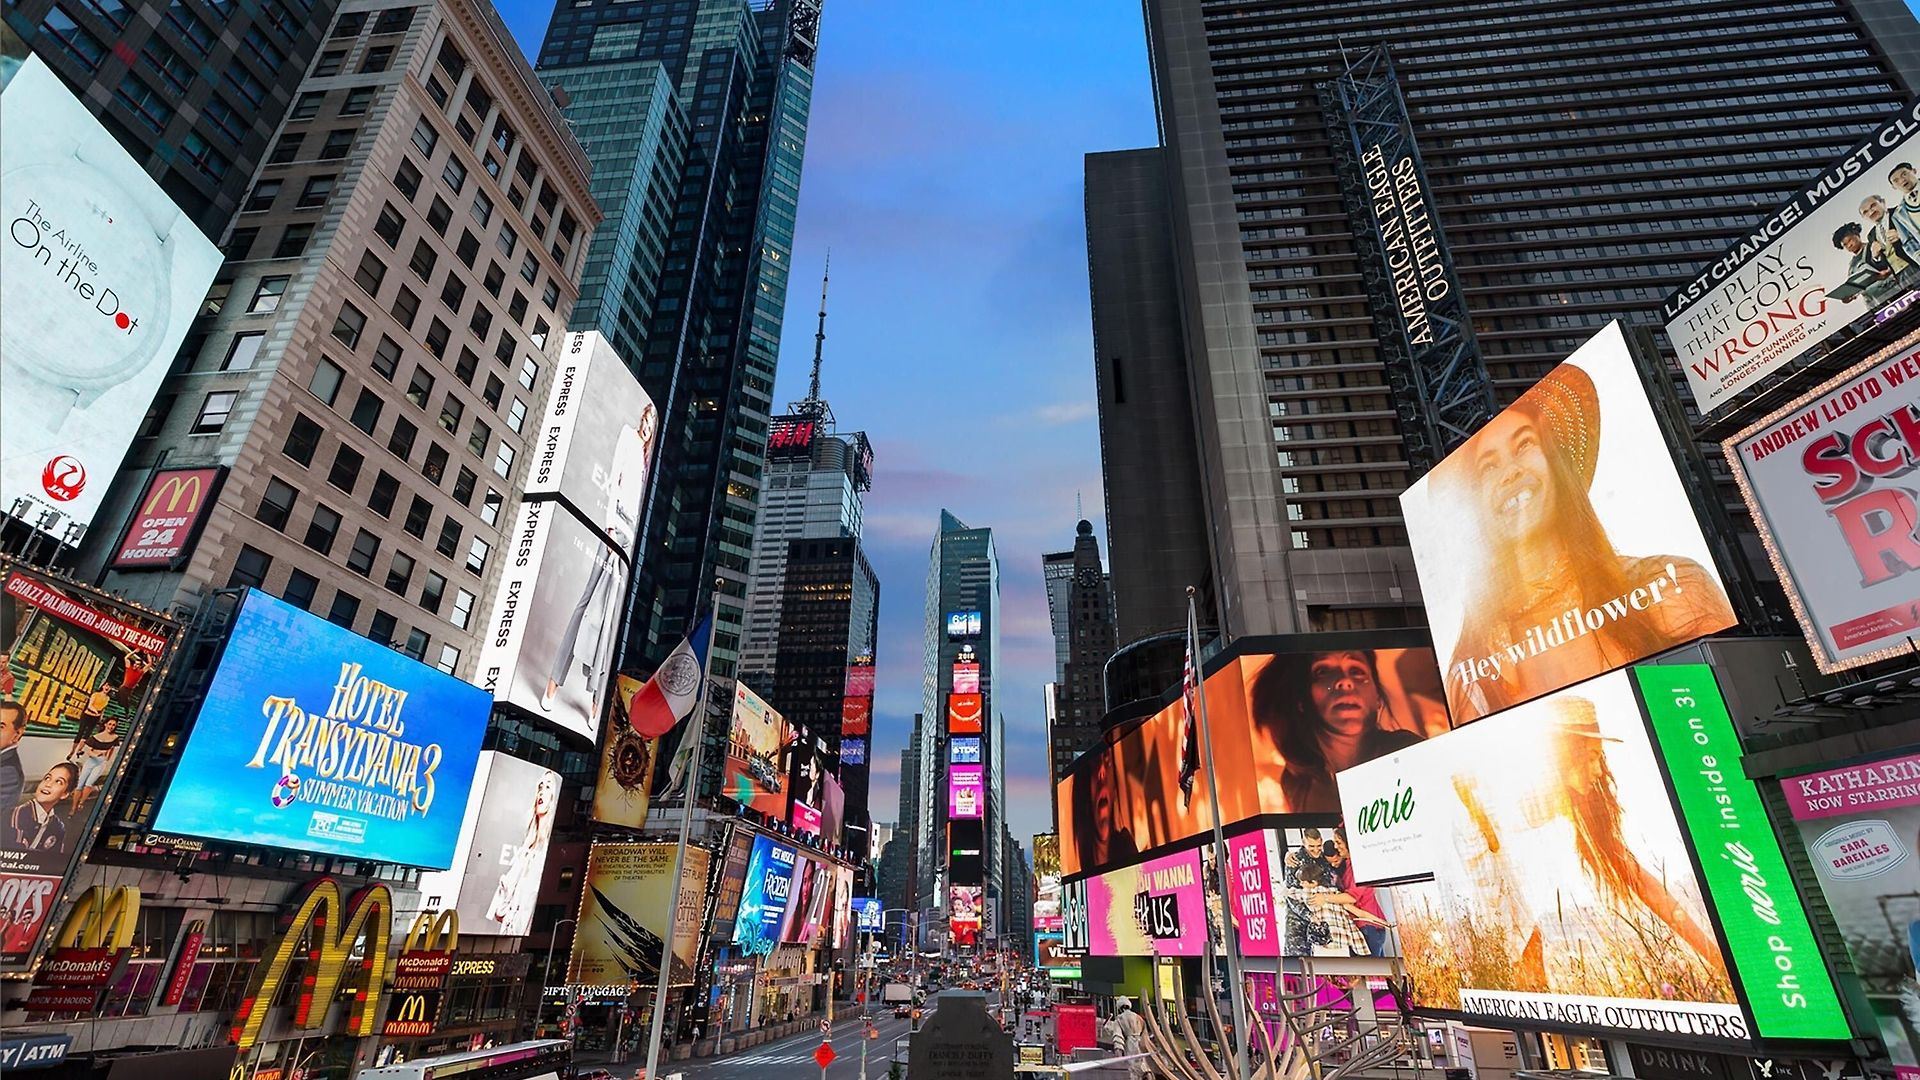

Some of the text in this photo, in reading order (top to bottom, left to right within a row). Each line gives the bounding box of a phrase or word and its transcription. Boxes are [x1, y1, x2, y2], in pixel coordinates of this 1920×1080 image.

[25, 198, 98, 276] The Airline,
[1362, 144, 1433, 345] AMERICAN EAGLE
[1392, 156, 1449, 302] OUTFITTERS
[1664, 274, 1708, 318] LAST
[1712, 201, 1804, 281] CHANCE!
[1805, 142, 1873, 206] MUST
[11, 217, 138, 335] On the Dot
[1685, 242, 1784, 332] THE PLAY
[1683, 256, 1814, 357] THAT GOES
[1690, 287, 1827, 382] WRONG
[1720, 323, 1806, 382] BROADWAY'S FUNNIEST
[1709, 320, 1827, 399] AND LONGEST-RUNNING PLAY
[554, 366, 576, 416] EXPRESS
[1820, 376, 1883, 424] LLOYD
[537, 426, 561, 484] EXPRESS
[26, 493, 45, 507] JAPAN
[47, 485, 72, 500] JAL
[138, 529, 176, 546] 24
[142, 517, 188, 528] OPEN
[516, 501, 542, 567] EXPRESS
[121, 547, 179, 559] HOURS
[8, 577, 165, 653] CHAZZ PALMINTERI JOINS THE CAST!
[495, 581, 523, 648] EXPRESS
[1457, 563, 1682, 688] Hey wildflower!
[16, 616, 104, 694] A BRONX
[18, 669, 72, 726] TALE
[325, 662, 408, 738] HOTEL
[1671, 688, 1696, 708] 3!
[960, 746, 979, 754] TDK
[1691, 717, 1709, 745] on
[245, 695, 442, 819] TRANSYLVANIA 3
[299, 777, 409, 822] SUMMER VACATION
[1358, 779, 1415, 835] aerie
[1700, 755, 1740, 829] inside
[1806, 795, 1842, 811] NOW
[1239, 845, 1259, 869] ARE
[1832, 844, 1890, 868] BAREILLES
[1840, 838, 1869, 854] SARA
[1153, 863, 1195, 891] WANNA
[1240, 869, 1262, 892] YOU
[1720, 841, 1782, 924] aerie
[1152, 897, 1179, 937] US.
[1241, 892, 1268, 916] WITH
[1246, 918, 1267, 940] US?
[41, 960, 112, 972] McDonald's
[398, 957, 450, 967] McDonald's
[451, 960, 495, 976] EXPRESS
[63, 996, 92, 1005] HOURS
[1463, 996, 1748, 1039] AMERICAN EAGLE OUTFITTERS
[1642, 1049, 1714, 1076] DRINK
